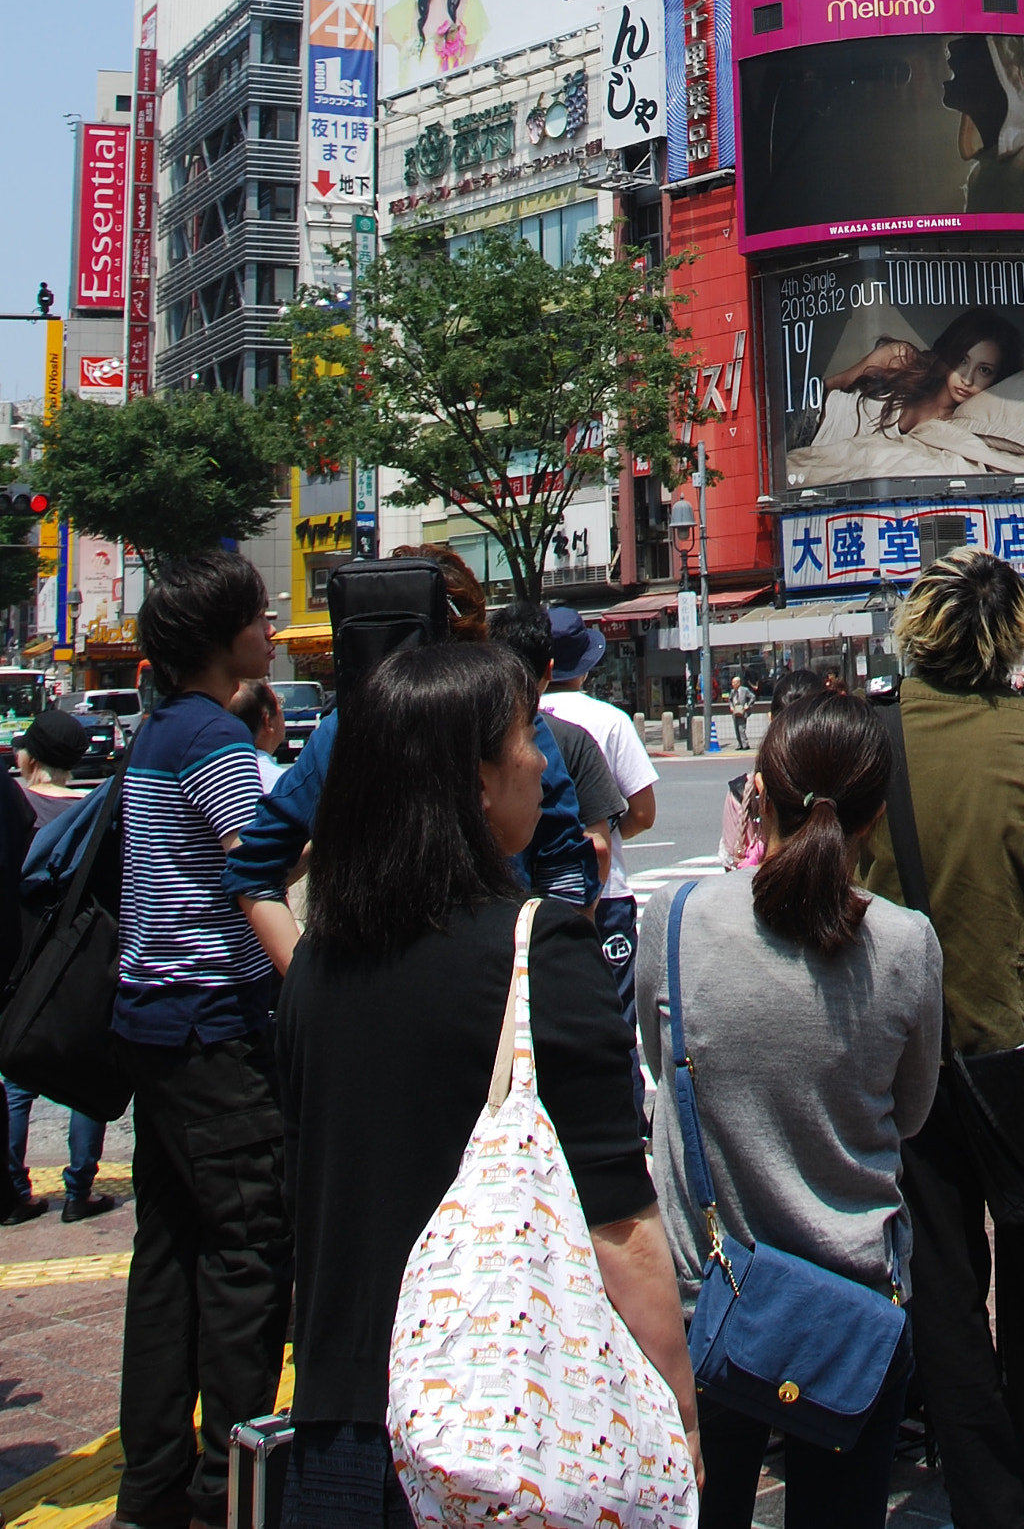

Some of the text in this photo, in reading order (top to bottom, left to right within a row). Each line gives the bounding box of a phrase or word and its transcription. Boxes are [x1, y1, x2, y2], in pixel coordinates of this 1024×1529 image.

[314, 95, 367, 108] ブックファースト
[312, 118, 368, 141] 夜11時
[322, 143, 358, 163] まで
[339, 174, 370, 196] 地下
[81, 128, 116, 302] Essential
[829, 218, 961, 235] WAKASA SEIKATSU CHANNEL
[781, 269, 836, 297] 4th Single
[885, 260, 970, 306] TOMOMI
[781, 281, 886, 322] 2013.6.12 OUT
[782, 319, 823, 413] 1%
